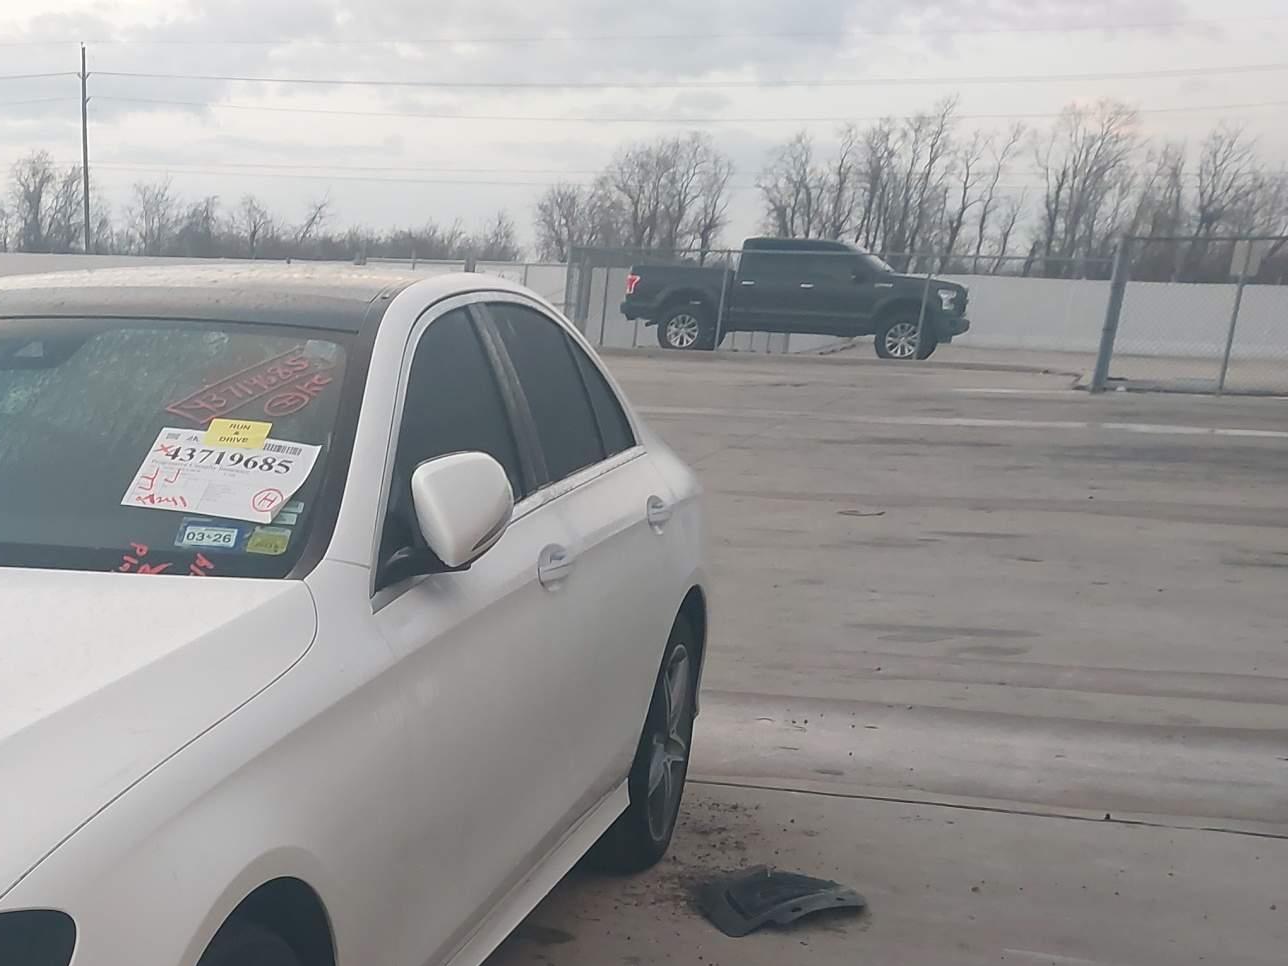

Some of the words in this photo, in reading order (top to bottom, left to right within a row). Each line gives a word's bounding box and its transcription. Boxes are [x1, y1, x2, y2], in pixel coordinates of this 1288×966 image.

[228, 423, 252, 431] RUN
[217, 435, 250, 444] DRIVE
[164, 445, 295, 475] 43719685
